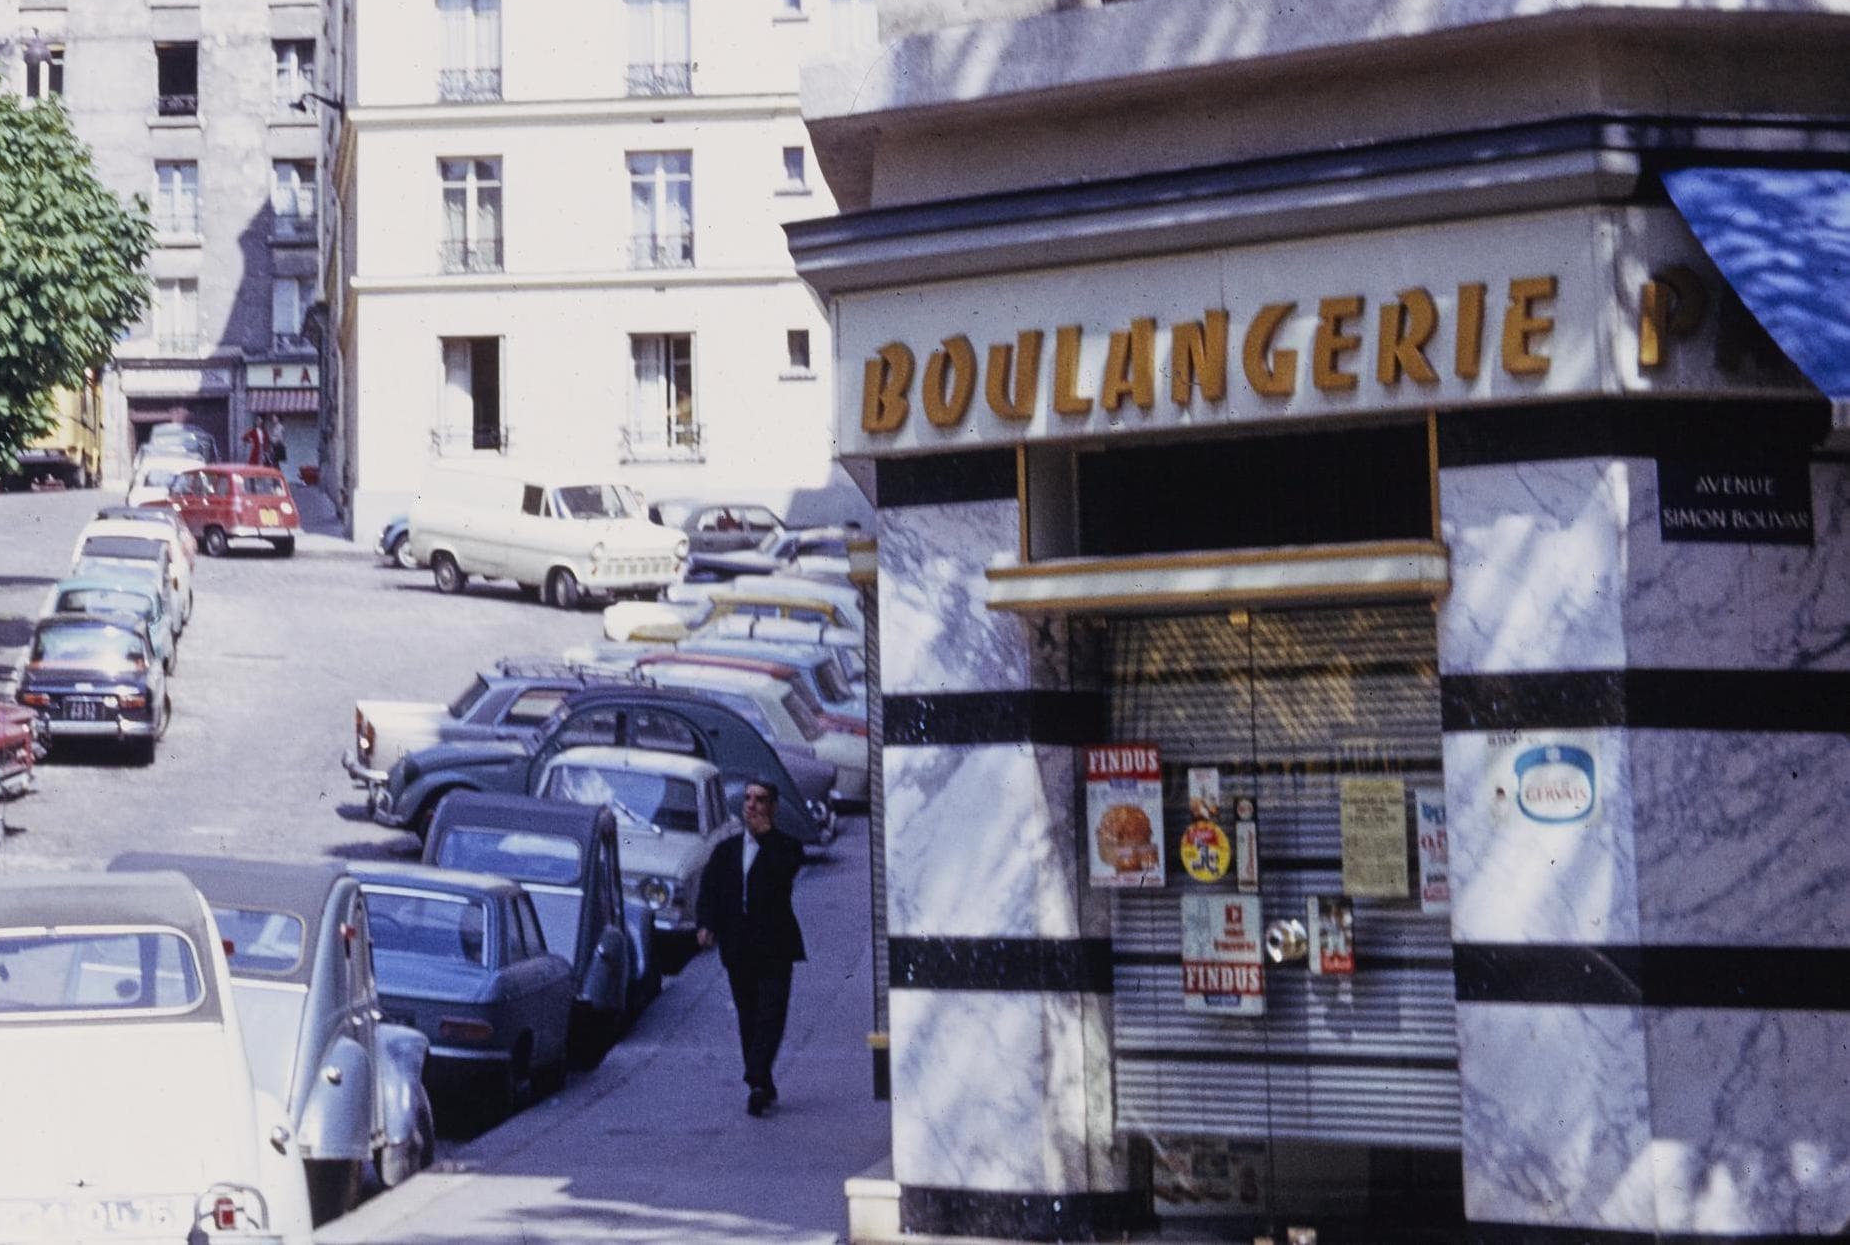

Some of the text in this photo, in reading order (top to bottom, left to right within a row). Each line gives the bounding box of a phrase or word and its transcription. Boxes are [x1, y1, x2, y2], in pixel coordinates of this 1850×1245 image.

[861, 276, 1558, 434] BOULANGERIE
[1696, 474, 1774, 496] AVENUE
[1662, 507, 1810, 530] SIMON BOLIVAR
[1088, 747, 1160, 773] FINDUS
[1524, 785, 1588, 803] GERVAIS
[1185, 964, 1261, 993] FINDUS
